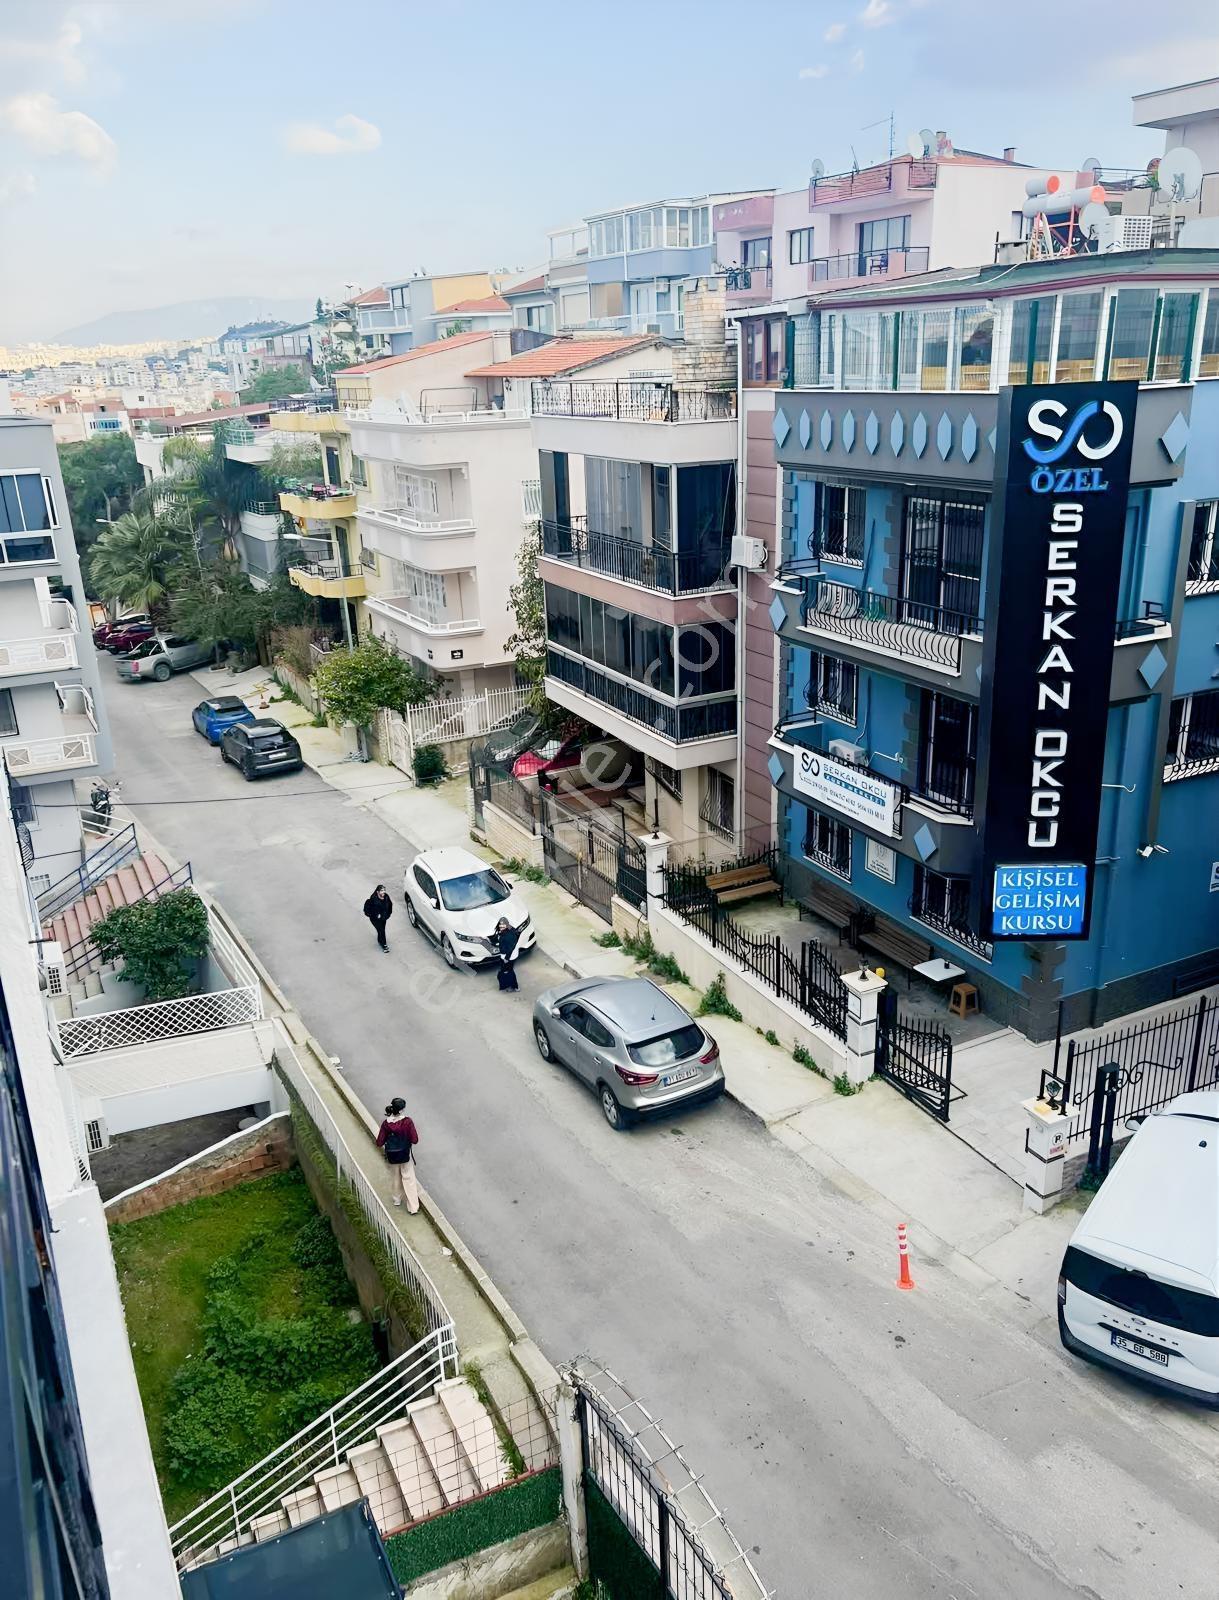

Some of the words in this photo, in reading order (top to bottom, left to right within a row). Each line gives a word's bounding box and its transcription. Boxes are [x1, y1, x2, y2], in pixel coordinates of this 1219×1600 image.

[1031, 465, 1109, 493] ÖZEL
[1037, 502, 1084, 711] SERKAN
[1027, 729, 1068, 848] OKCU
[1002, 869, 1079, 890] KİŞİSEL
[996, 890, 1080, 911] GELİŞİM
[1002, 914, 1073, 930] KURSU
